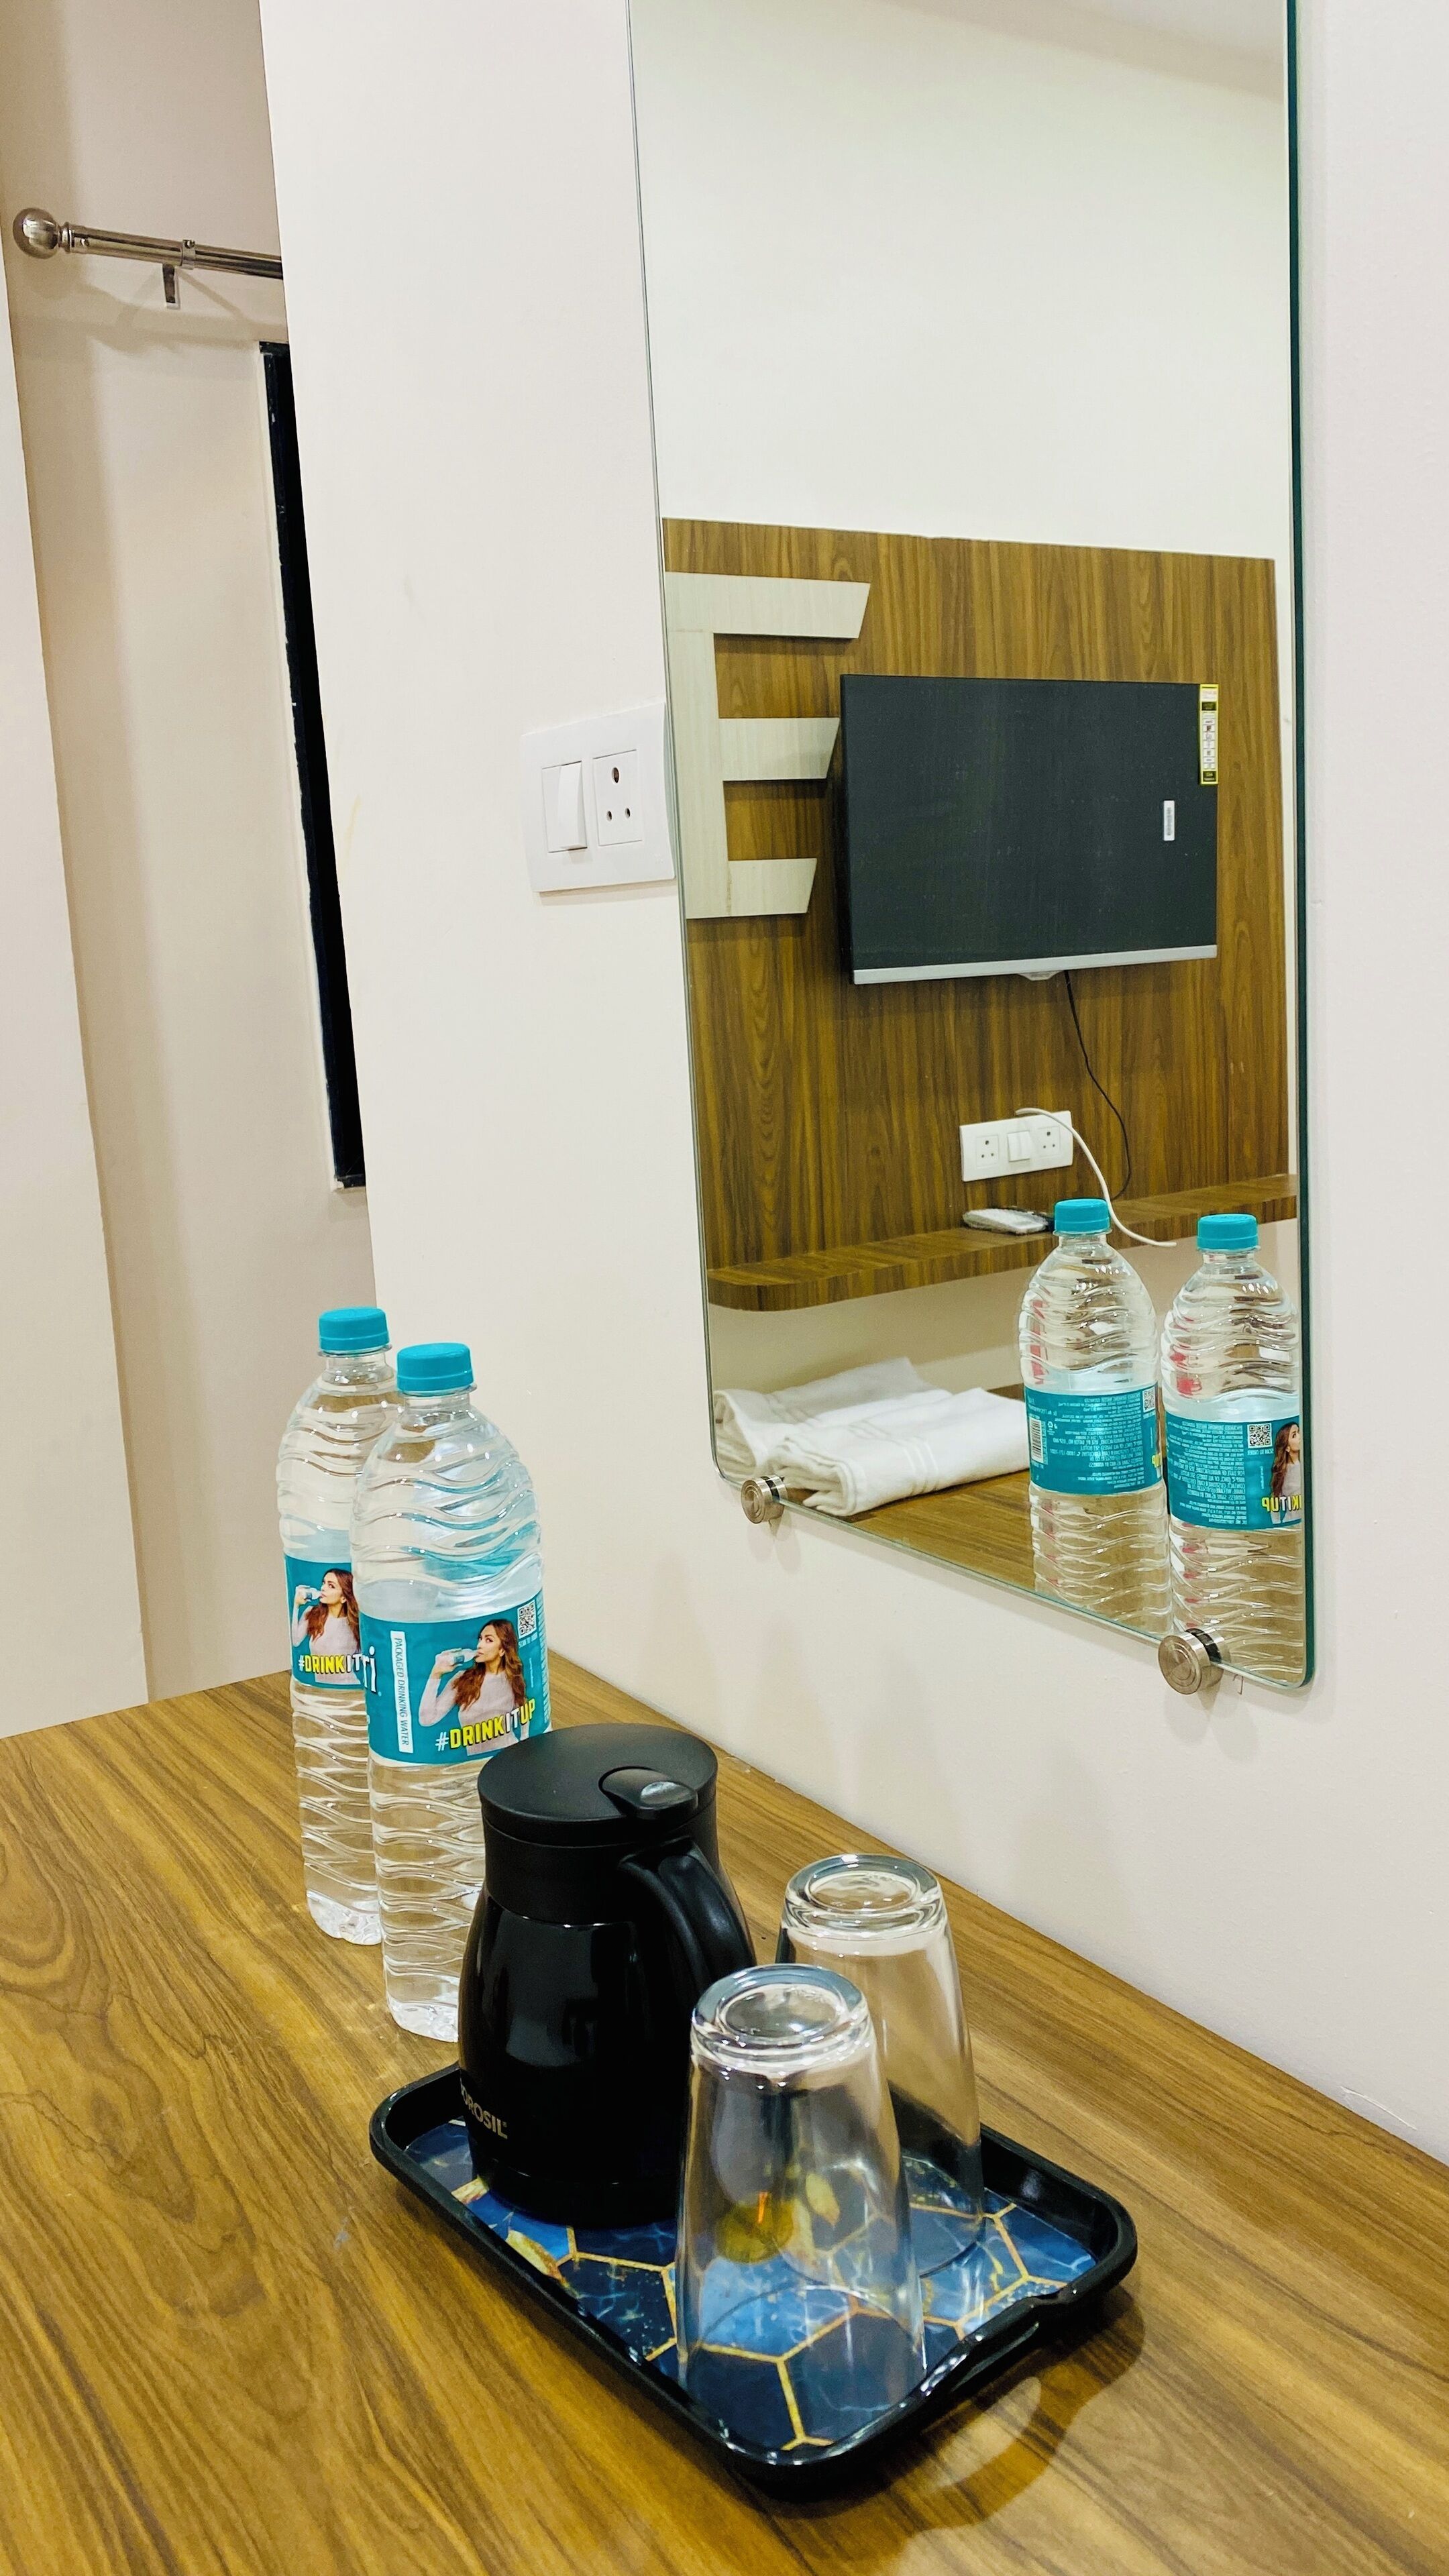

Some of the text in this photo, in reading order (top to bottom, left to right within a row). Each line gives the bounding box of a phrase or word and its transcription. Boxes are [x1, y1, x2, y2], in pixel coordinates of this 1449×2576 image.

[394, 1638, 409, 1746] PACKAGED DRINKING WATER
[435, 1699, 536, 1752] #DRINKITUP
